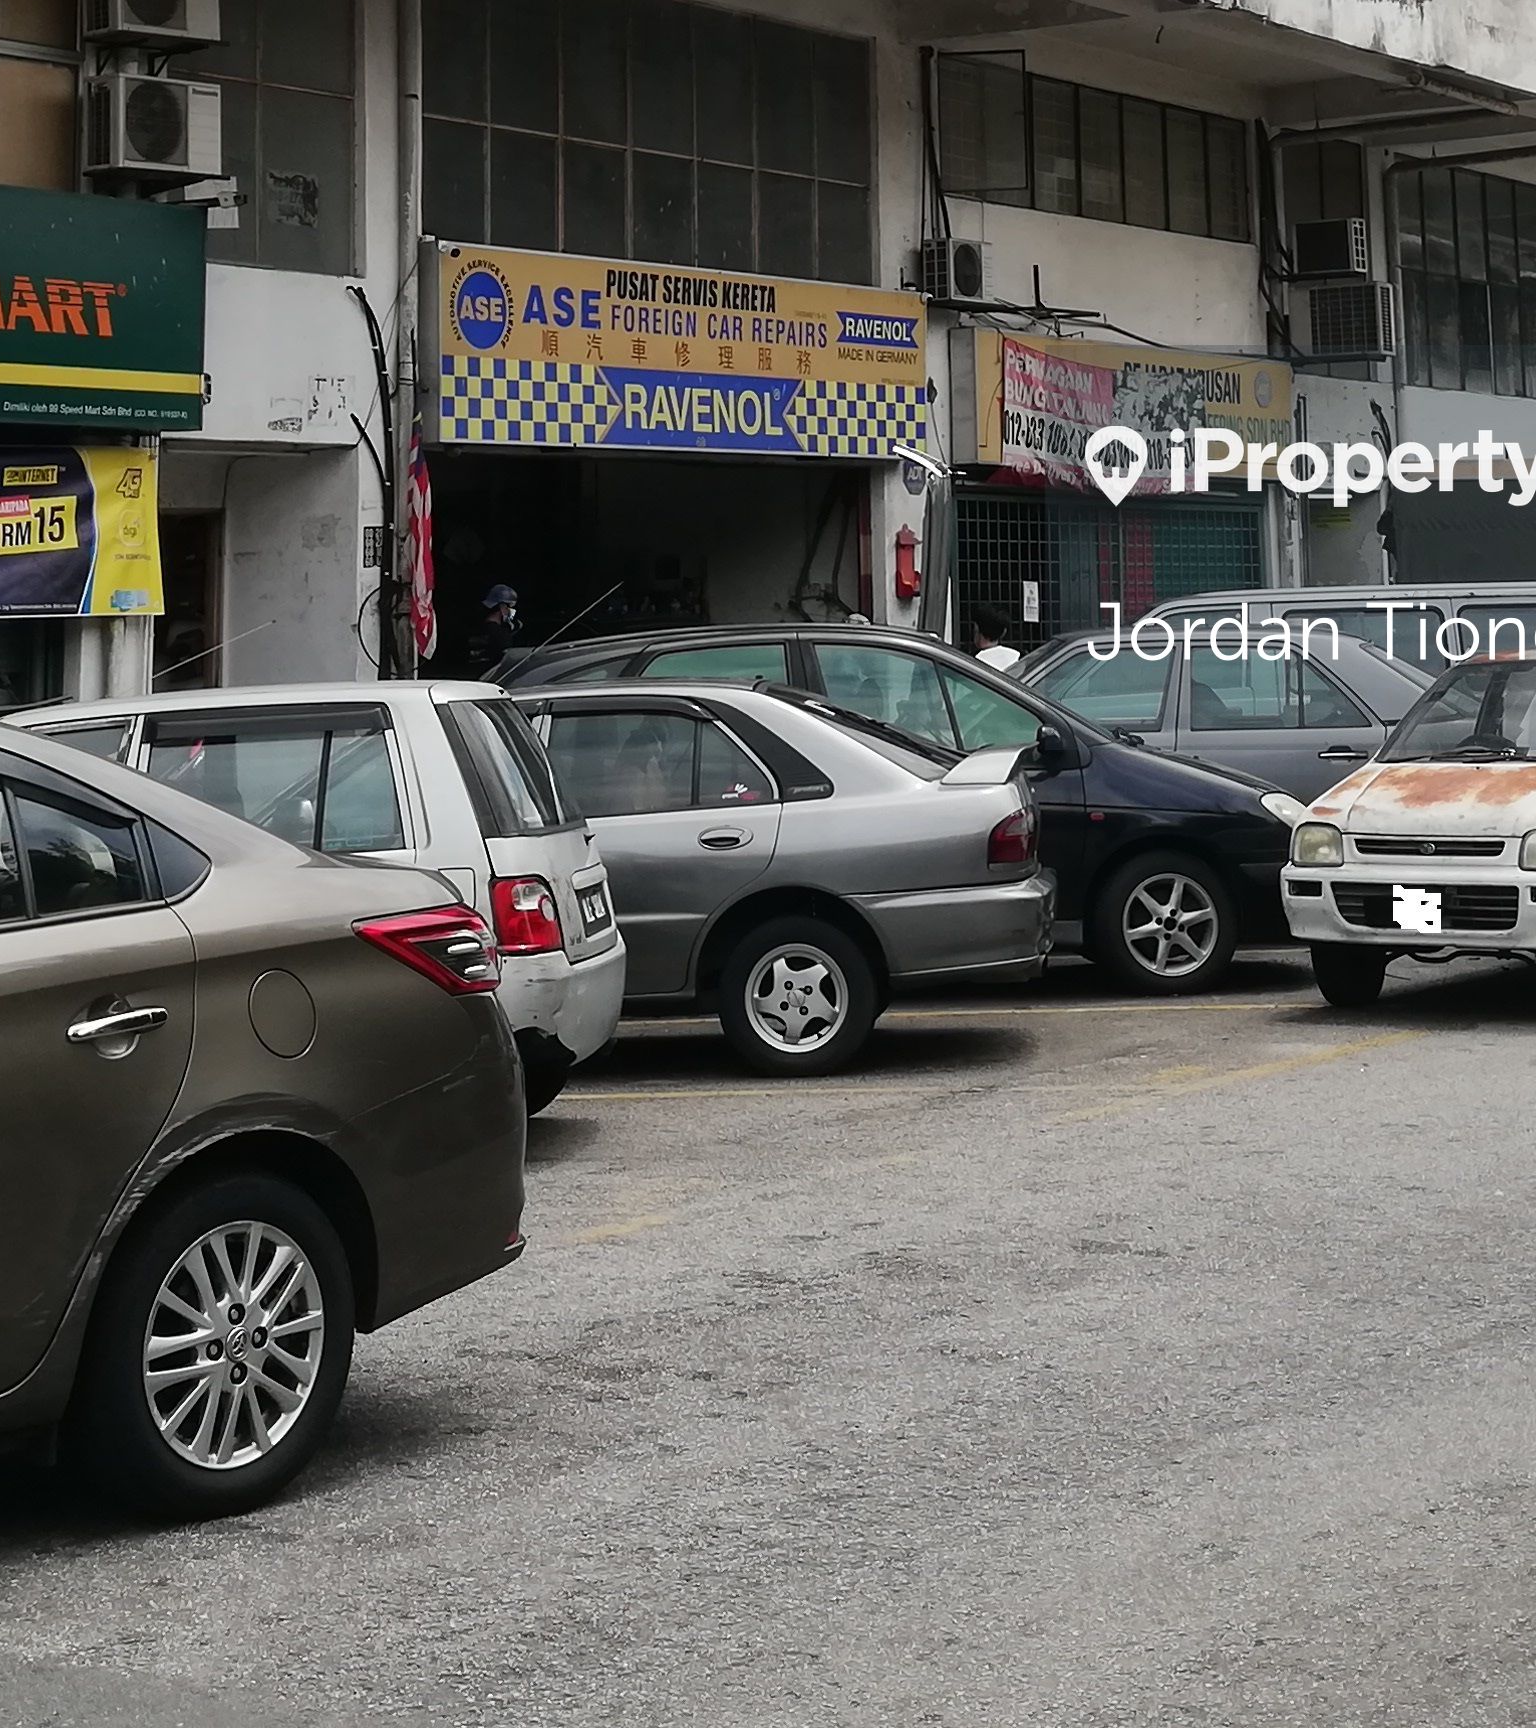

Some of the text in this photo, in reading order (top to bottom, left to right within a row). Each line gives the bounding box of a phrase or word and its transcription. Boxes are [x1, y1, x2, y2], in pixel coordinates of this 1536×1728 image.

[449, 258, 514, 350] AUTOMOTIVE SERVICE EXCELLENCE
[460, 295, 503, 322] ASE
[522, 284, 601, 330] ASE
[606, 269, 776, 314] PUSAT SERVIS KERETA
[611, 304, 828, 349] FOREIGN CAR REPAIRS
[845, 316, 911, 342] RAVENOL
[837, 347, 918, 365] MADE IN GERMANY
[60, 403, 83, 416] Speed
[625, 383, 784, 436] RAVENOL
